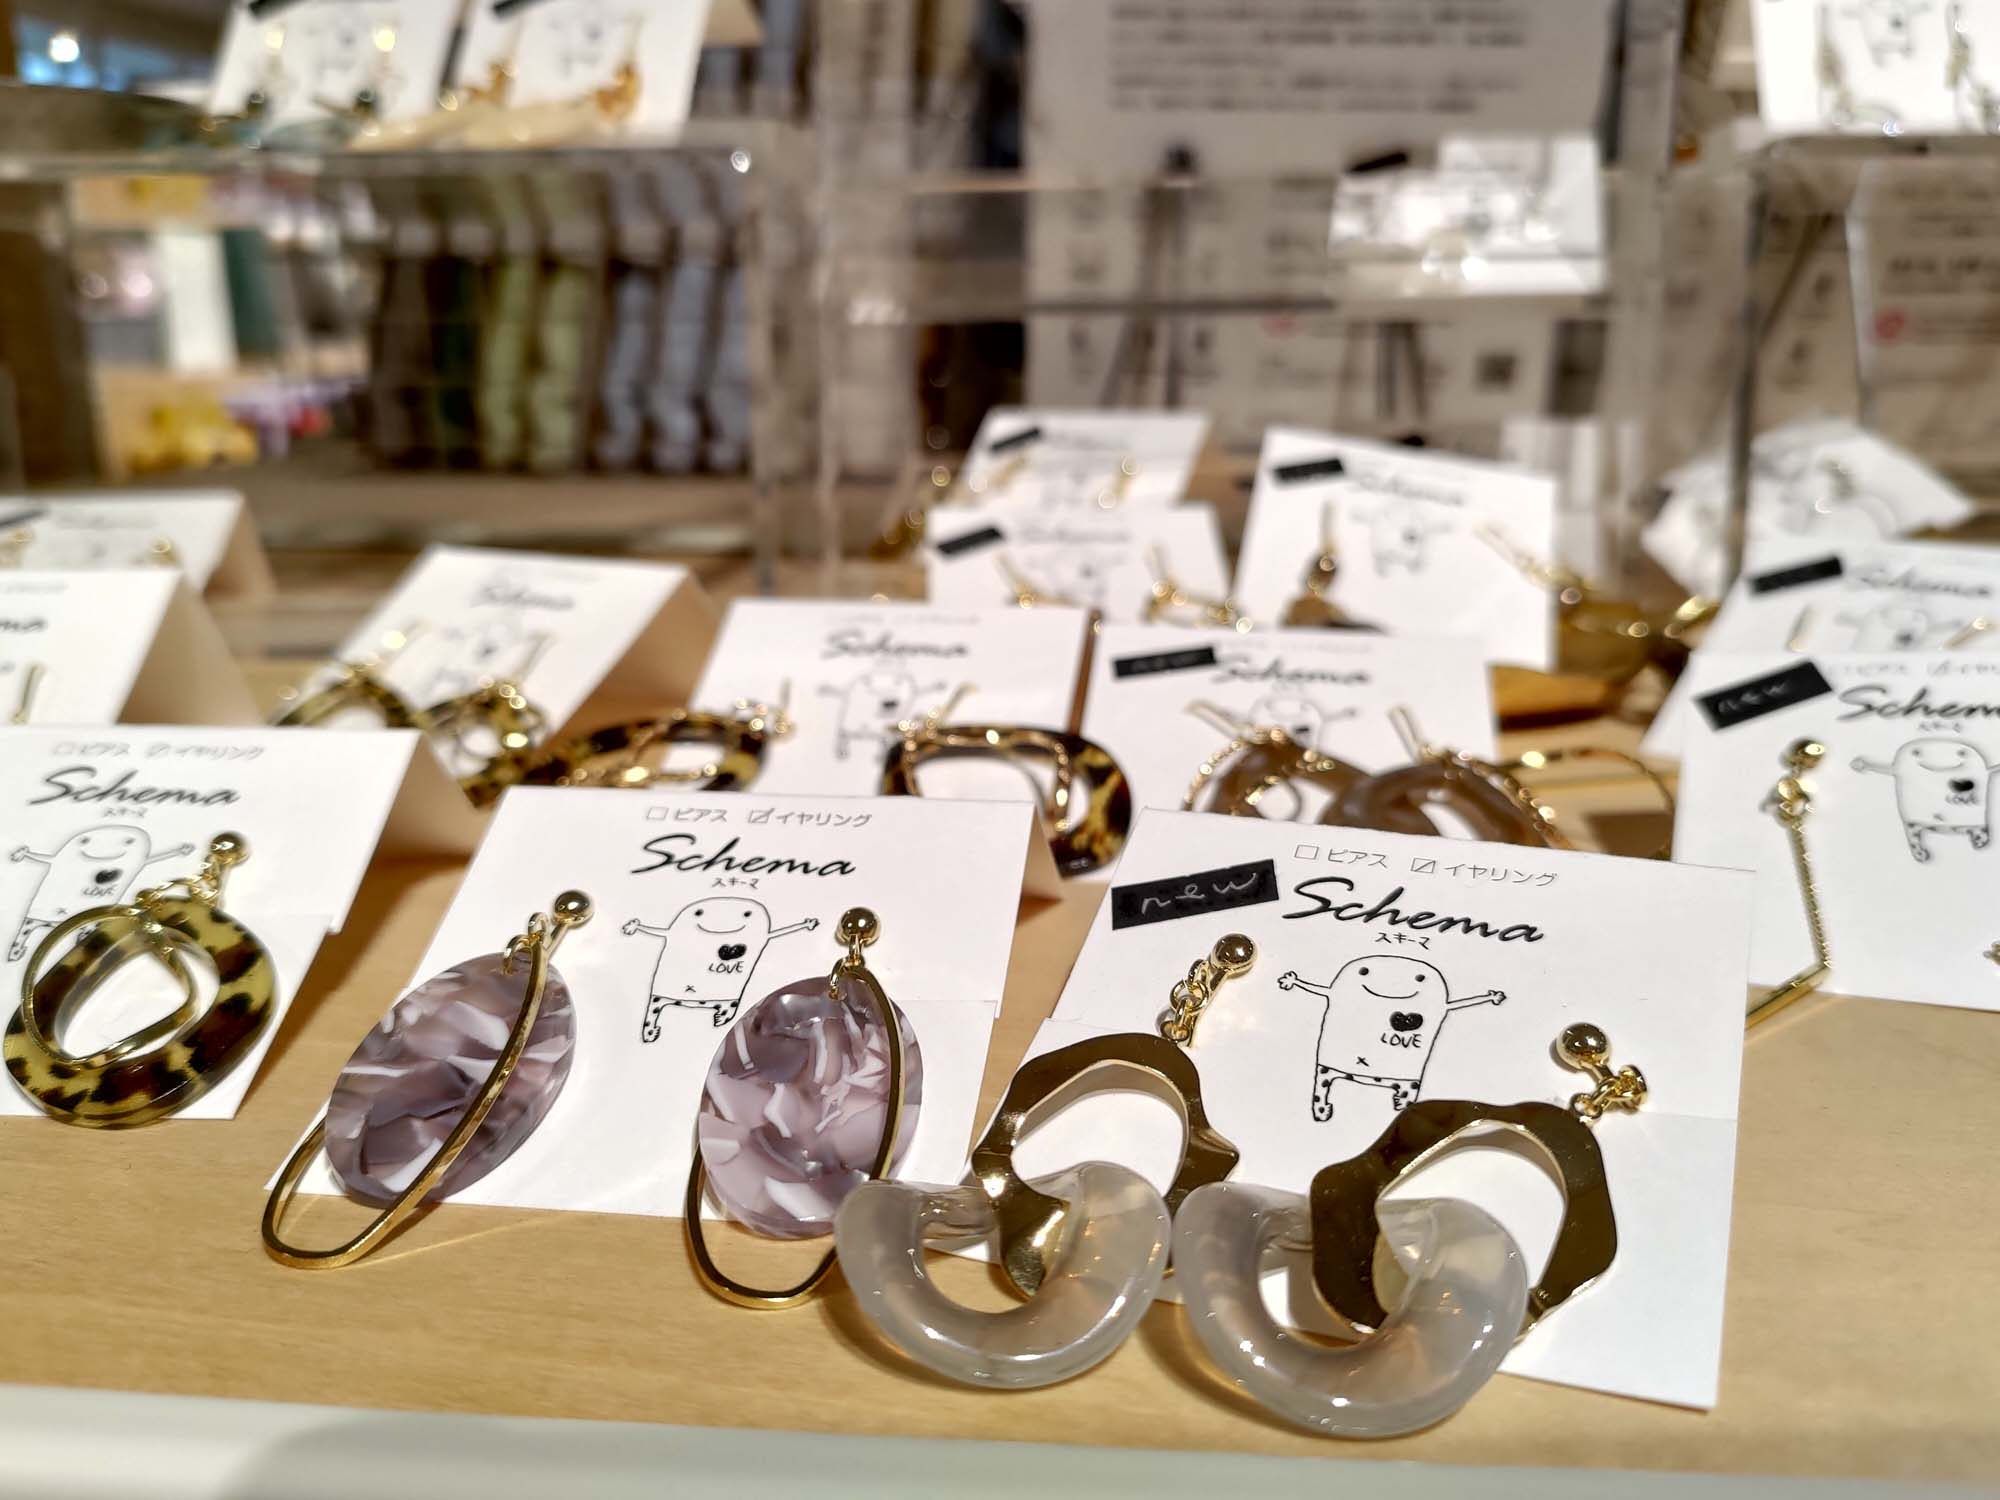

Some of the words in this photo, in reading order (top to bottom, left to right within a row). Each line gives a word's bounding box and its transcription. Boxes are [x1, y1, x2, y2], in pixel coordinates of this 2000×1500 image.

[1836, 684, 2000, 721] Schem
[27, 766, 240, 805] Schema
[674, 808, 728, 822] ピアス
[776, 813, 873, 827] イヤリング
[631, 833, 857, 876] Schema
[1328, 848, 1390, 869] ピアス
[1443, 863, 1559, 886] イヤリング
[711, 877, 760, 889] スキーマ
[1141, 872, 1257, 915] new
[1281, 876, 1545, 943] Schema
[1375, 932, 1432, 950] スキーマ
[708, 961, 745, 973] LOVE
[1380, 1031, 1423, 1049] LOVE
